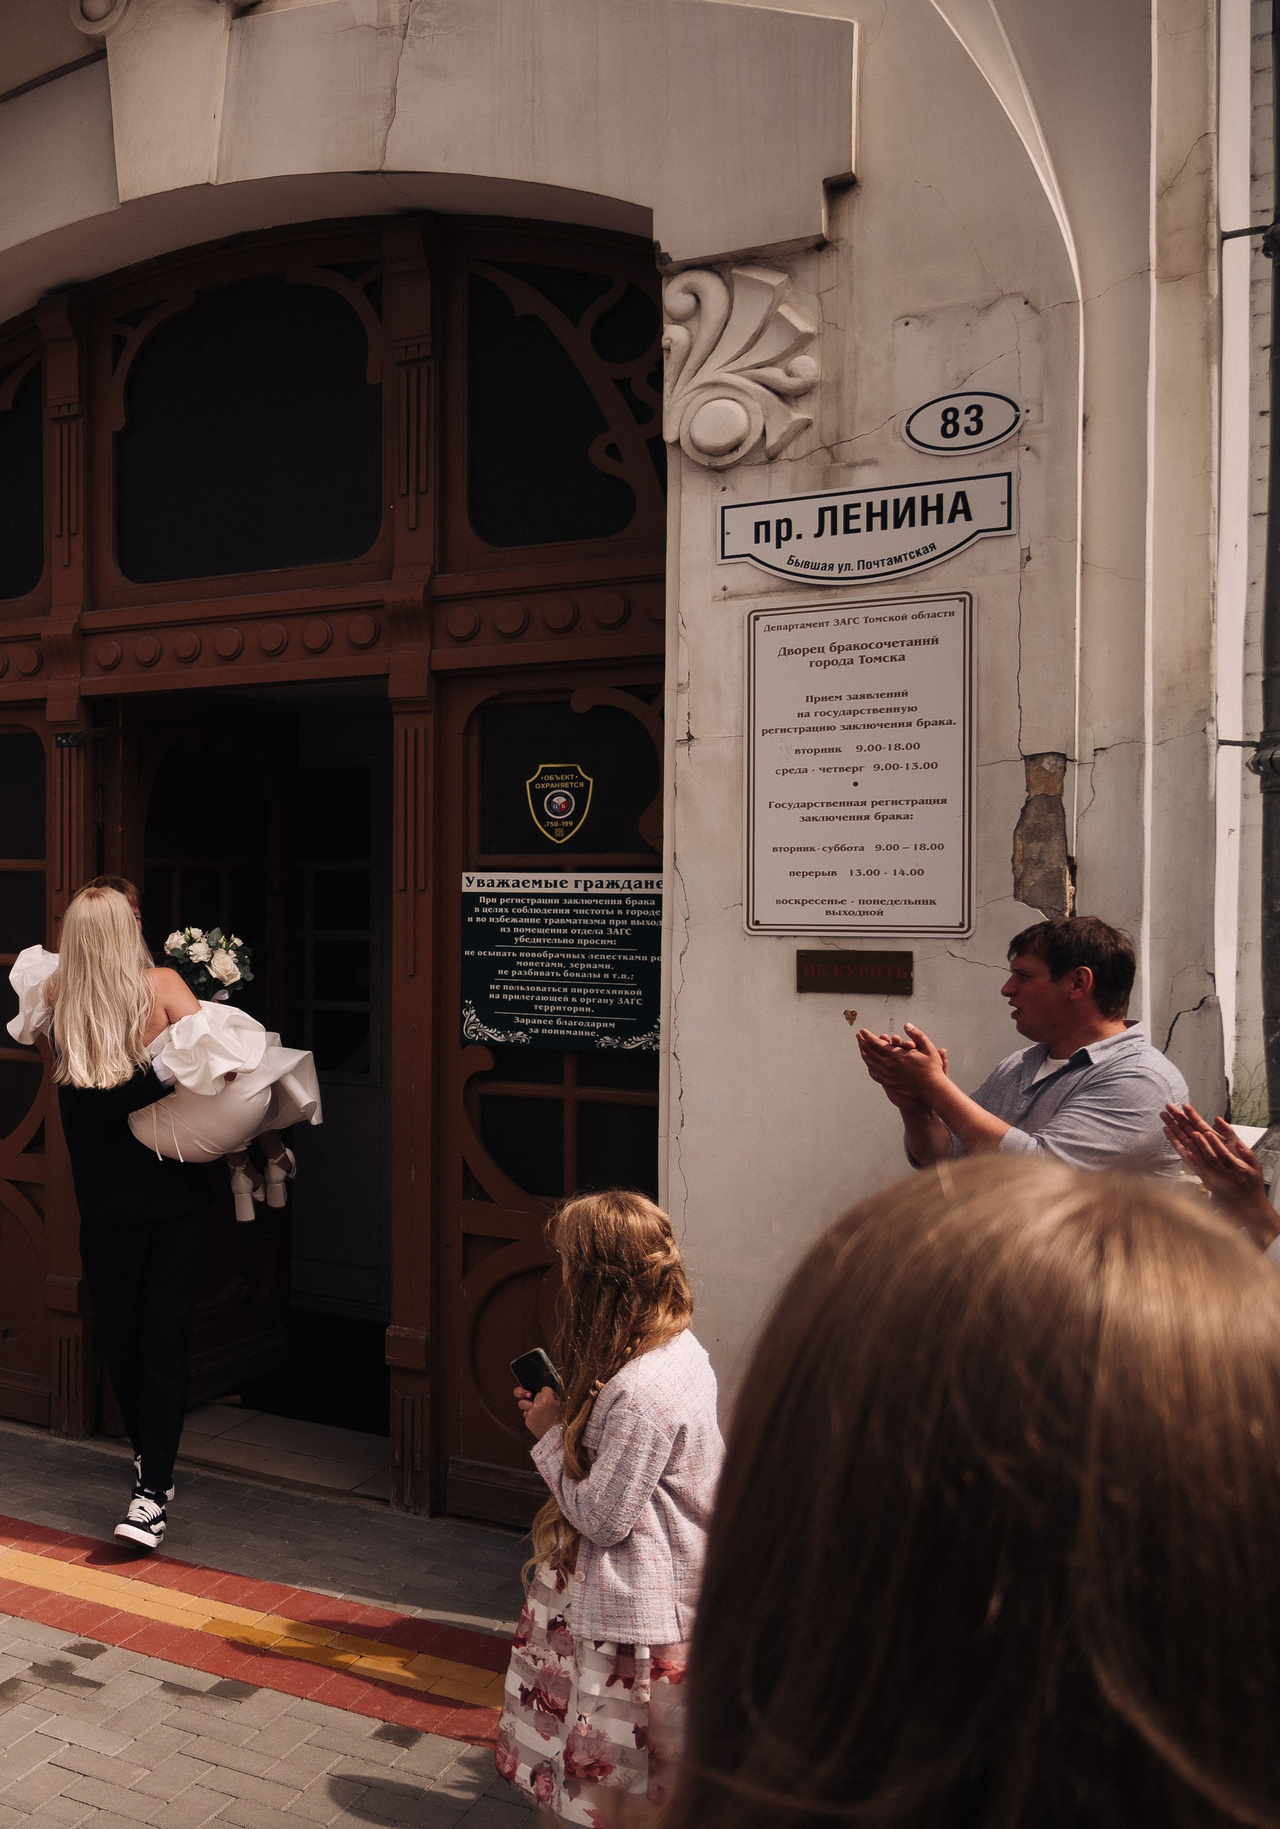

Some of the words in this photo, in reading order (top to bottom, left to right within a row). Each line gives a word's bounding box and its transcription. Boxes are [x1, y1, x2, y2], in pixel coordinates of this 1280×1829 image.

[940, 404, 983, 439] 83
[754, 517, 802, 549] пр.
[814, 490, 973, 539] ЛЕНИНА
[787, 555, 834, 572] Бывшая
[837, 561, 854, 574] ул.
[857, 542, 937, 571] Почтамтская
[763, 620, 830, 633] Департамент
[833, 617, 860, 627] ЗАГС
[863, 612, 907, 624] Томской
[911, 609, 955, 620] области
[777, 646, 825, 658] Дворец
[829, 636, 939, 653] бракосочетаний
[809, 657, 854, 669] города
[858, 653, 905, 664] Томска
[806, 694, 842, 704] Прием
[846, 689, 908, 701] заявлений
[797, 710, 810, 718] на
[814, 705, 917, 718] государственную
[761, 724, 836, 736] регистрацию
[840, 720, 912, 731] заключения
[916, 717, 956, 727] брака.
[794, 746, 842, 755] вторник
[856, 742, 921, 753] 9.00-18.00
[775, 766, 808, 775] среда
[819, 765, 864, 775] четверг
[873, 762, 938, 771] 9.00-13.00
[768, 799, 867, 809] Государственная
[871, 798, 947, 808] регистрация
[799, 813, 870, 822] заключения
[874, 812, 913, 822] брака:
[822, 844, 864, 852] суббота
[913, 843, 944, 851] 18.00
[465, 876, 568, 889] Уважаемые
[574, 878, 663, 892] граждане
[480, 896, 497, 905] При
[500, 897, 559, 905] регистрации
[626, 897, 655, 907] брака
[858, 898, 937, 906] понедельник
[512, 906, 570, 914] соблюдения
[626, 909, 660, 917] городе
[825, 908, 884, 916] выходной
[489, 915, 541, 923] избежание
[514, 935, 574, 944] убедительно
[519, 951, 585, 959] новобрачных
[512, 968, 560, 977] разбивать
[563, 970, 600, 978] бокалы
[803, 965, 825, 977] НЕ
[834, 965, 908, 978] КУРИТЬ
[503, 985, 568, 993] пользоваться
[571, 987, 642, 995] пиротехникой
[502, 994, 568, 1002] прилегающей
[580, 997, 614, 1005] органу
[533, 1004, 594, 1013] территории.
[514, 1016, 554, 1025] Заранее
[556, 1017, 615, 1028] благодарим
[541, 1028, 599, 1037] понимание.
